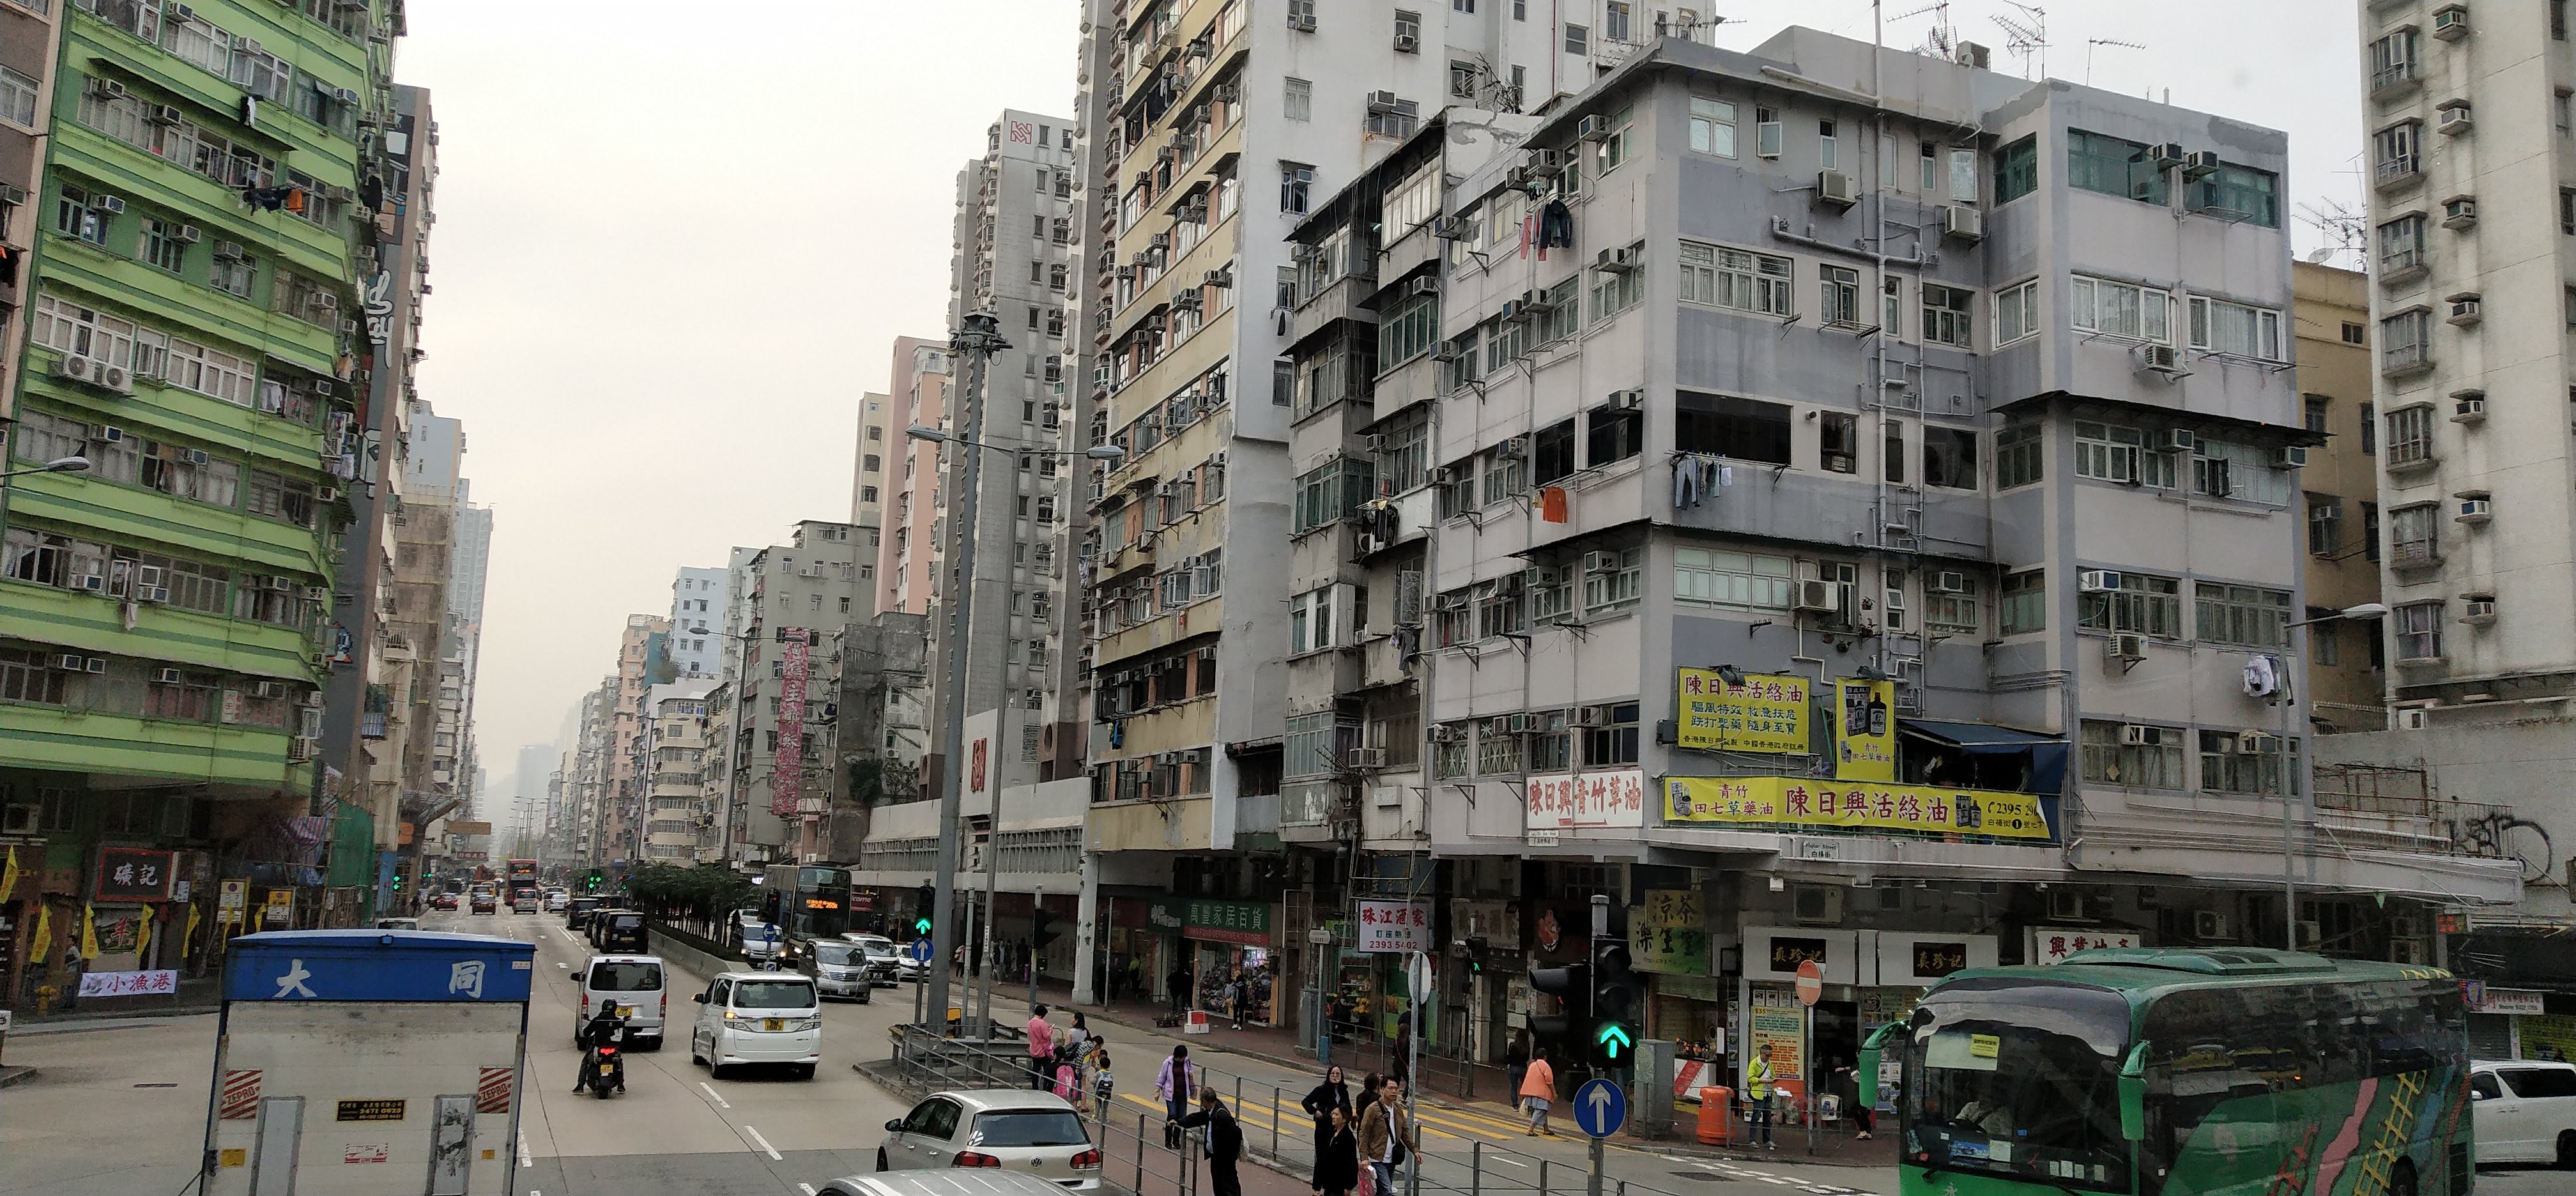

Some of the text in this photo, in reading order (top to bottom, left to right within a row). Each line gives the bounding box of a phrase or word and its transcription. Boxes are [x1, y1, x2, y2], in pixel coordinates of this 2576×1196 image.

[1685, 675, 1803, 703] 陳日興活絡油
[1691, 702, 1797, 721] 驅風特效 救急扶危
[1691, 716, 1797, 735] 跌打聖藥 隨身至寶
[1864, 742, 1878, 752] 青竹
[1853, 753, 1890, 762] 田七草藥油
[1529, 775, 1641, 816] 陳日興青竹草油
[1718, 783, 1749, 799] 青竹
[1694, 801, 1774, 816] 田七草藥油
[1786, 785, 1949, 824] 陳日興活絡油
[1997, 802, 2021, 815] 2395
[1362, 907, 1425, 926] 珠江酒家
[1653, 895, 1698, 924] 涼茶
[1245, 933, 1261, 942] STORE
[107, 972, 172, 992] 小漁港
[272, 958, 486, 999] 大 同
[226, 1086, 256, 1105] ZEPRO
[482, 1084, 507, 1101] ZEPRO
